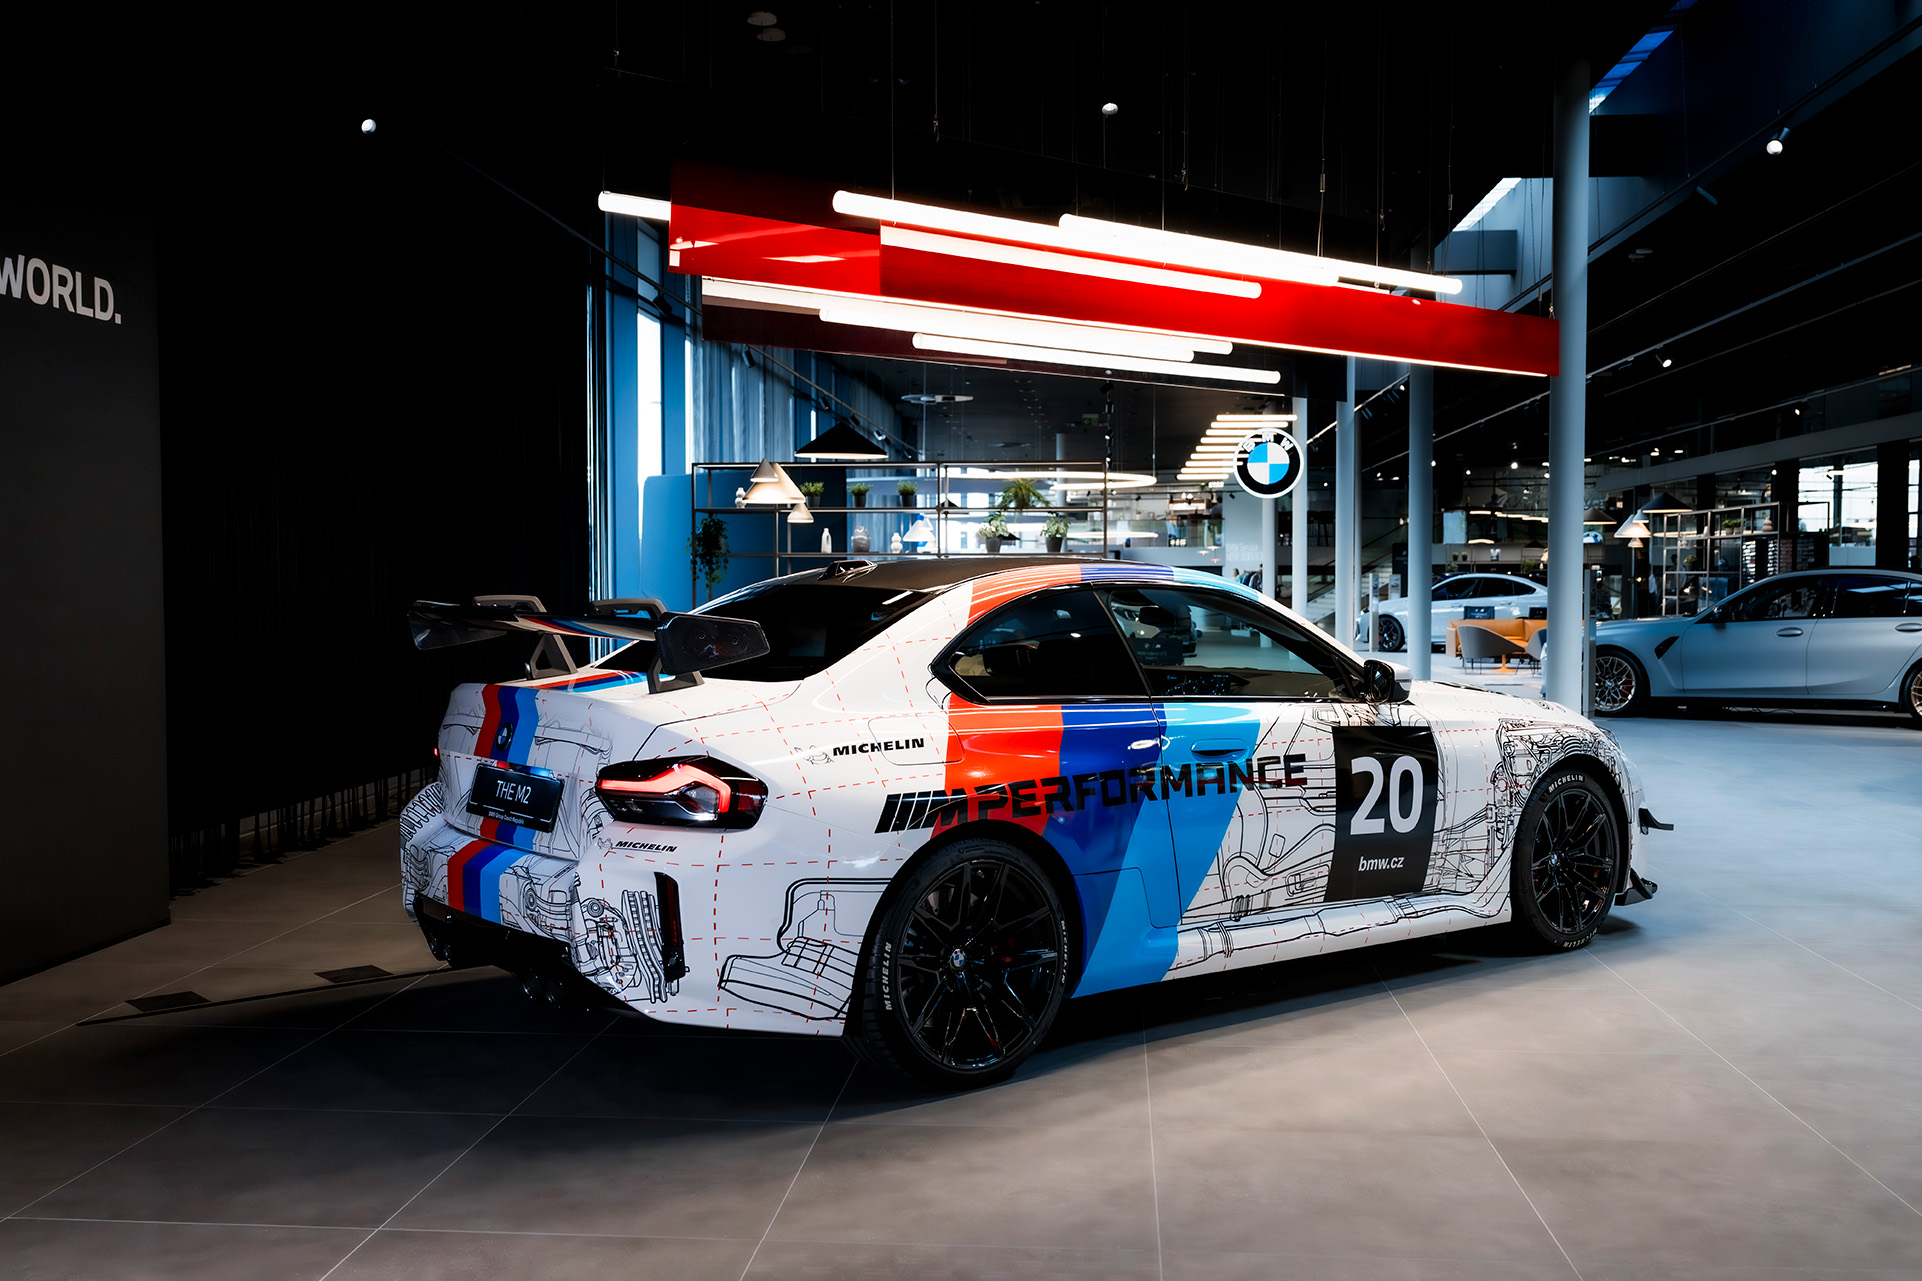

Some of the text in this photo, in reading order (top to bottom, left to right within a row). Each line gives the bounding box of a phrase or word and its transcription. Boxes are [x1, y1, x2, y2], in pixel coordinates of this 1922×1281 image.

[0, 253, 122, 325] WORLD.
[832, 737, 925, 757] MICHELIN
[496, 780, 532, 803] THE M2
[974, 753, 1309, 821] PERFORMANCE
[1350, 755, 1424, 836] 20
[1547, 775, 1585, 794] MICHELIN
[615, 840, 678, 852] MICHELIN
[1358, 855, 1405, 872] bmw.cz
[1060, 920, 1070, 984] MICHELIN
[881, 941, 893, 1011] MICHELIN
